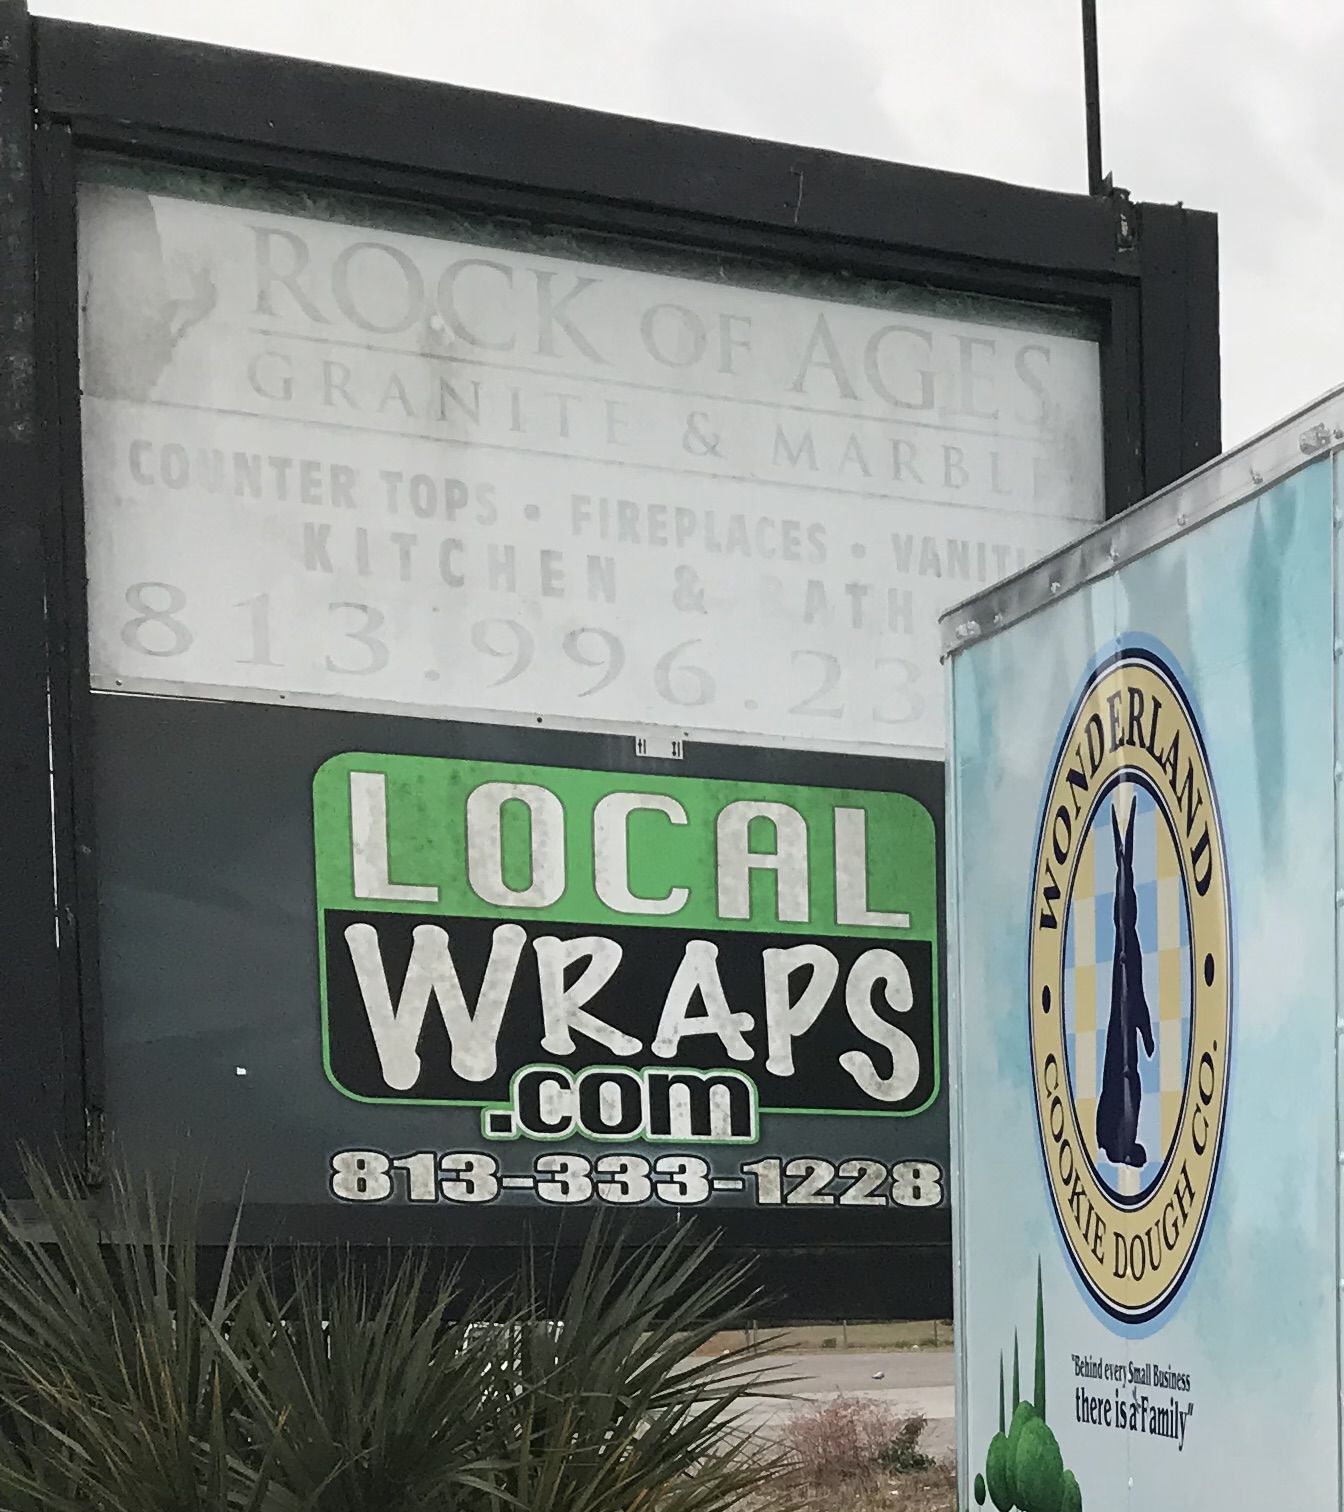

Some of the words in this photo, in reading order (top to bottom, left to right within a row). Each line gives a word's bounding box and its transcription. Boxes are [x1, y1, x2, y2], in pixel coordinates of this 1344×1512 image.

[248, 222, 615, 368] ROCK
[640, 303, 752, 376] OF
[783, 312, 1053, 429] AGES
[247, 350, 630, 447] GRANITE
[682, 410, 728, 461] &
[128, 439, 358, 510] COUNTER
[379, 470, 498, 527] TOPS
[571, 493, 828, 565] FIREPLACES
[303, 522, 617, 606] KITCHEN
[672, 564, 707, 614] &
[348, 770, 912, 929] LOCAL
[1038, 686, 1214, 932] WONDERLAND
[343, 922, 920, 1101] WRAPS
[488, 1070, 756, 1138] .com
[1042, 1052, 1106, 1280] COOKIE
[1112, 1171, 1198, 1283] DOUGH
[1190, 1037, 1219, 1158] CO.
[329, 1150, 944, 1207] 813-333-1228
[1071, 1353, 1102, 1379] "Behind
[1104, 1362, 1126, 1388] every
[1128, 1361, 1151, 1385] Small
[1153, 1364, 1190, 1391] Business
[1075, 1386, 1111, 1427] there
[1115, 1388, 1127, 1430] is
[1140, 1396, 1193, 1451] Family"
